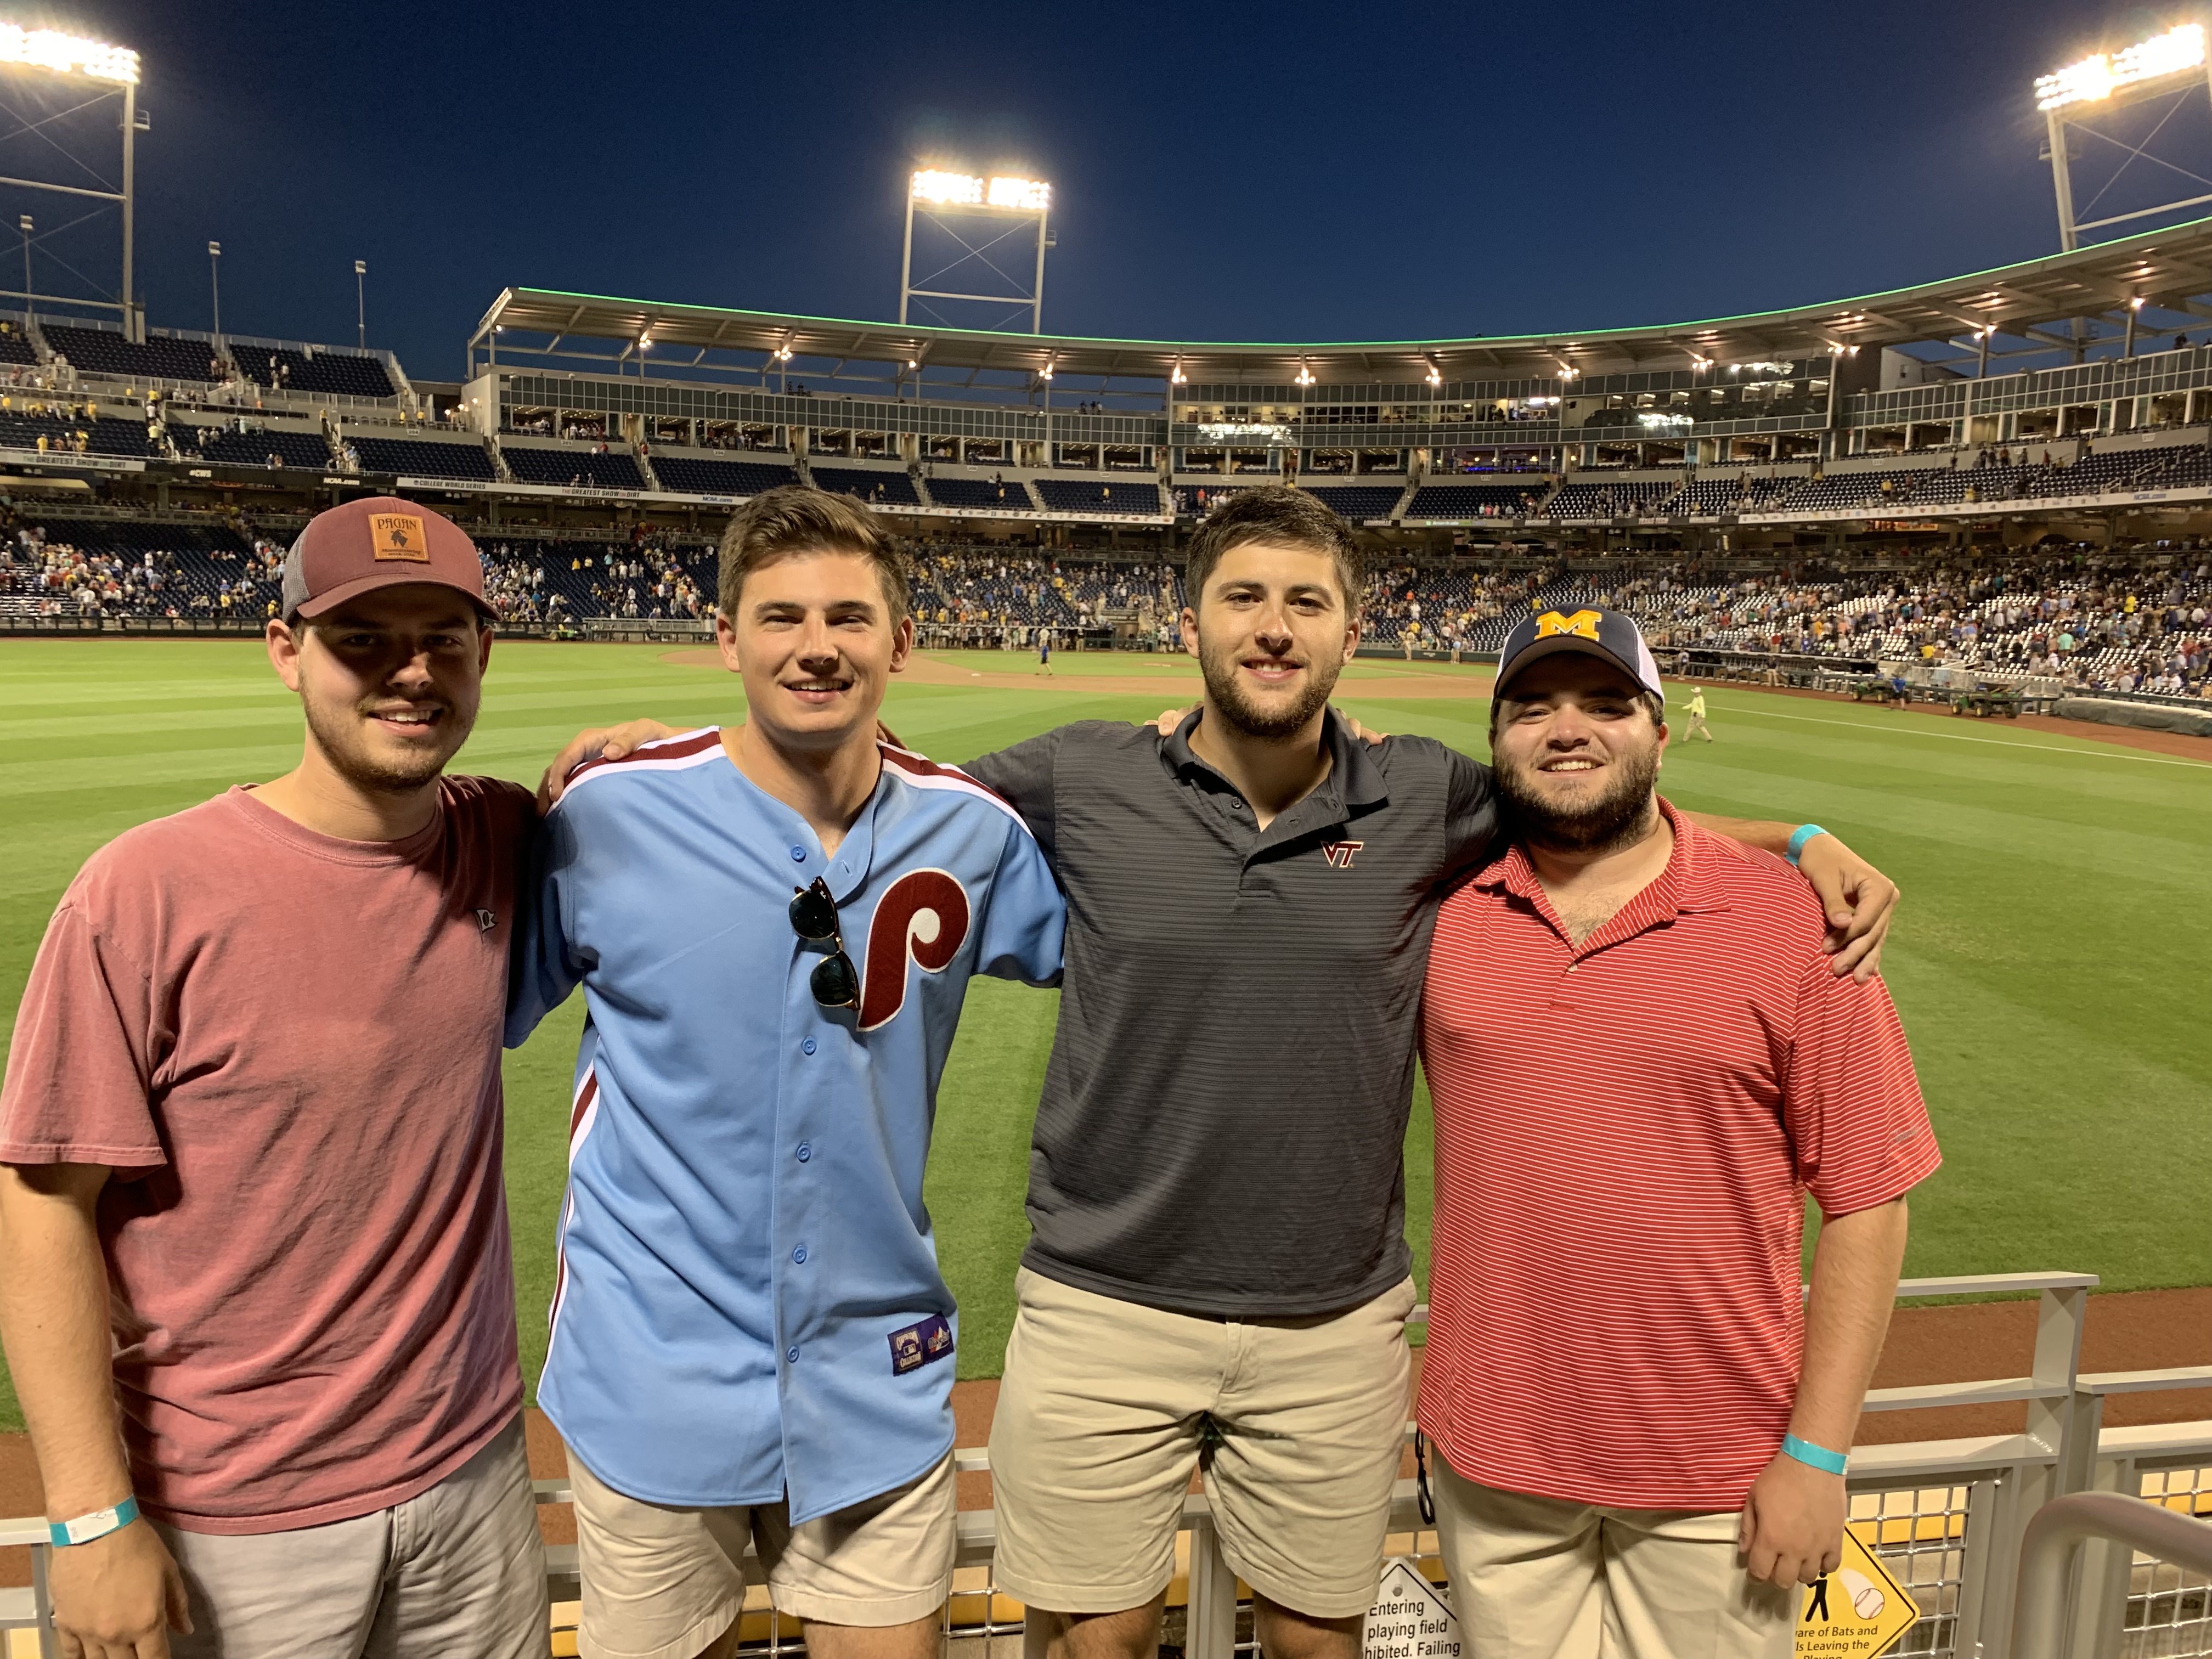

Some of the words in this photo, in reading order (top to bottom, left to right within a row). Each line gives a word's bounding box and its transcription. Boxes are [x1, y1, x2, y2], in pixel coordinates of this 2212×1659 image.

[36, 456, 74, 465] GREATEST
[76, 458, 98, 466] SHOW
[377, 518, 417, 530] PAGAN
[1534, 610, 1602, 641] M
[1320, 840, 1364, 868] VT
[1369, 1599, 1424, 1616] Entering
[1368, 1622, 1415, 1642] playing
[1420, 1618, 1447, 1634] field
[1795, 1629, 1815, 1638] are
[1818, 1626, 1830, 1637] of
[1832, 1627, 1855, 1637] Bats
[1857, 1625, 1878, 1635] and
[1417, 1640, 1460, 1657] Failing
[1796, 1641, 1804, 1651] ls
[1807, 1640, 1849, 1652] Leaving
[1852, 1639, 1870, 1650] the
